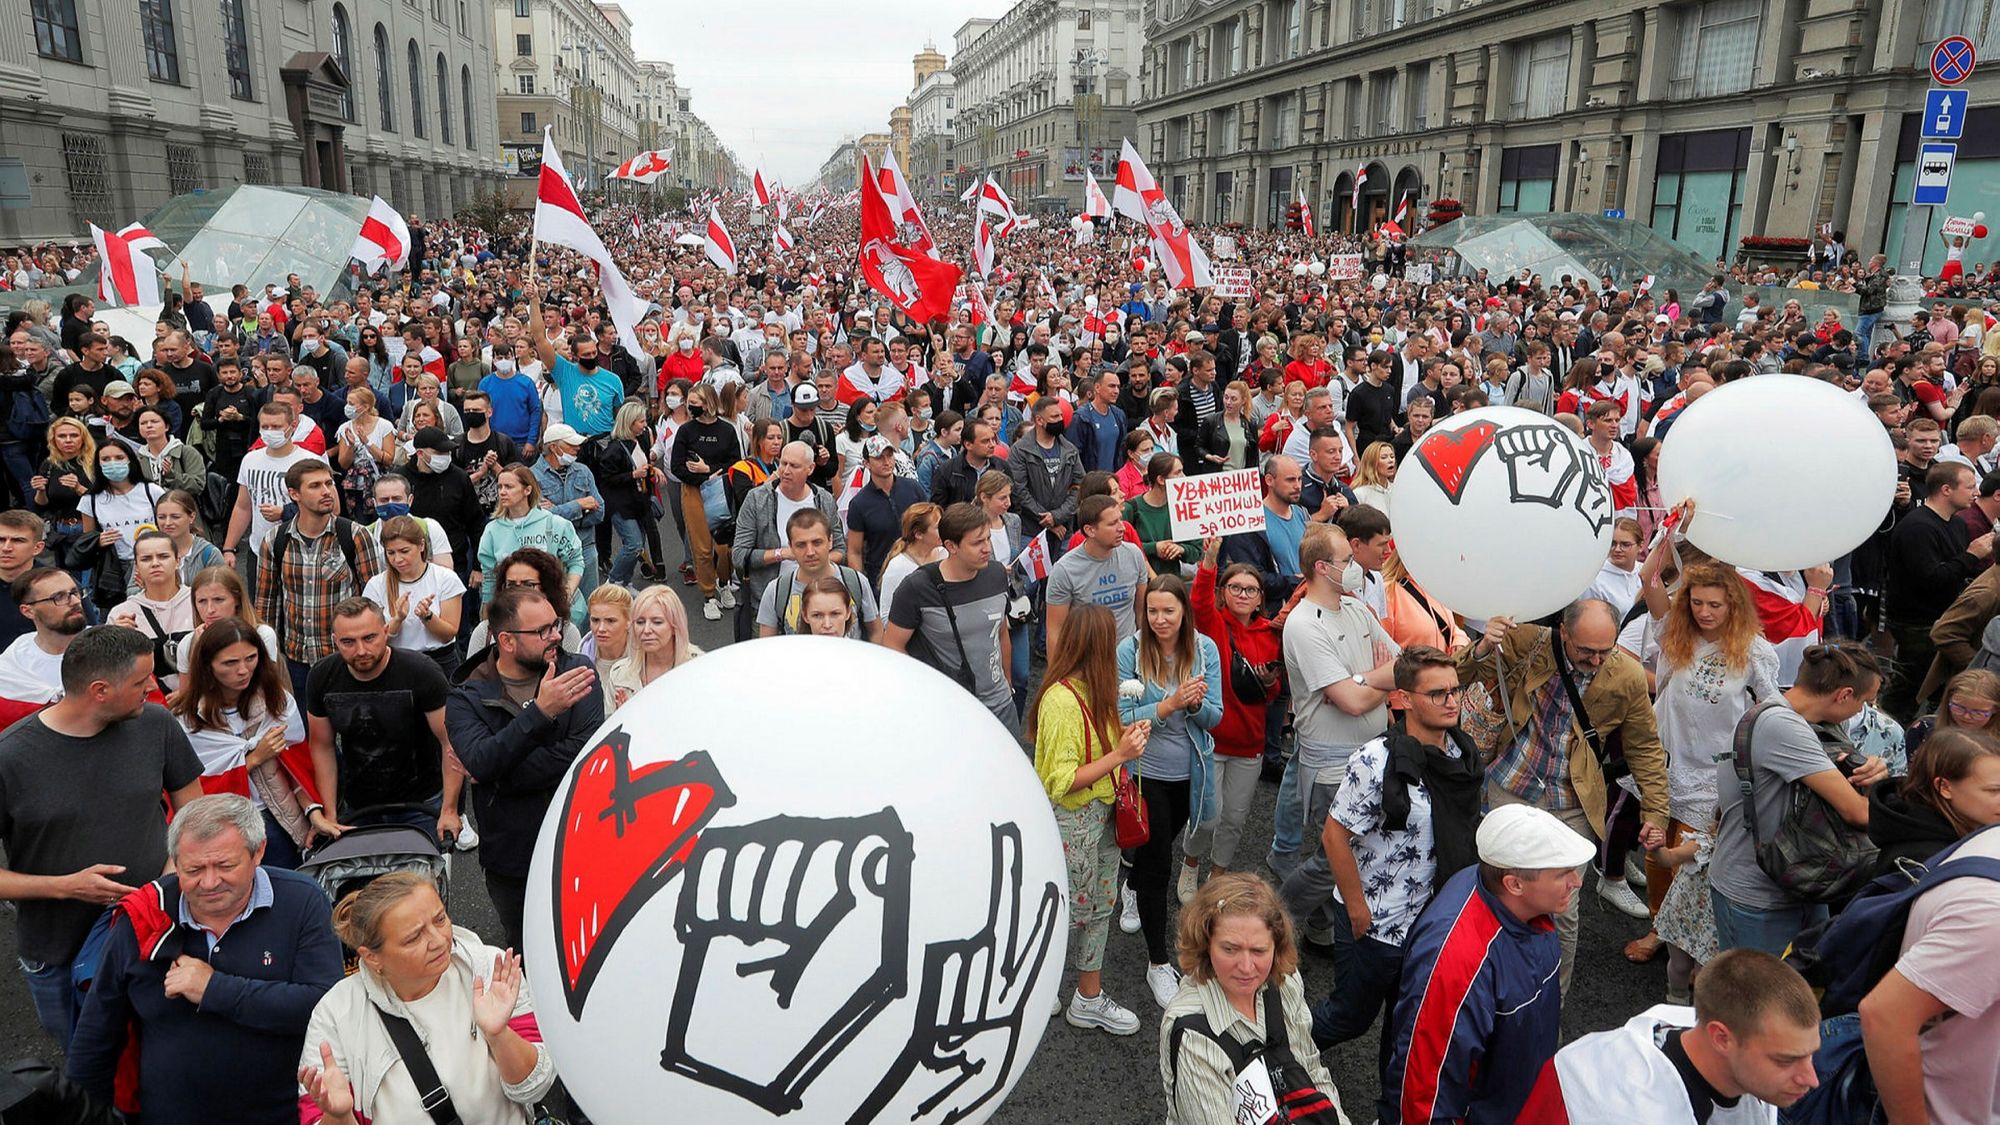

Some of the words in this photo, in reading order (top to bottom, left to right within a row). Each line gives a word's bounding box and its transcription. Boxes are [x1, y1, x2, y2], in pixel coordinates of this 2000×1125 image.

[1173, 470, 1260, 501] УВАЖЕНИЕ
[1174, 501, 1201, 522] НЕ
[1205, 495, 1262, 515] КУПИШЬ
[1219, 513, 1246, 529] 100
[1098, 573, 1117, 586] NO
[1092, 590, 1129, 605] MORE
